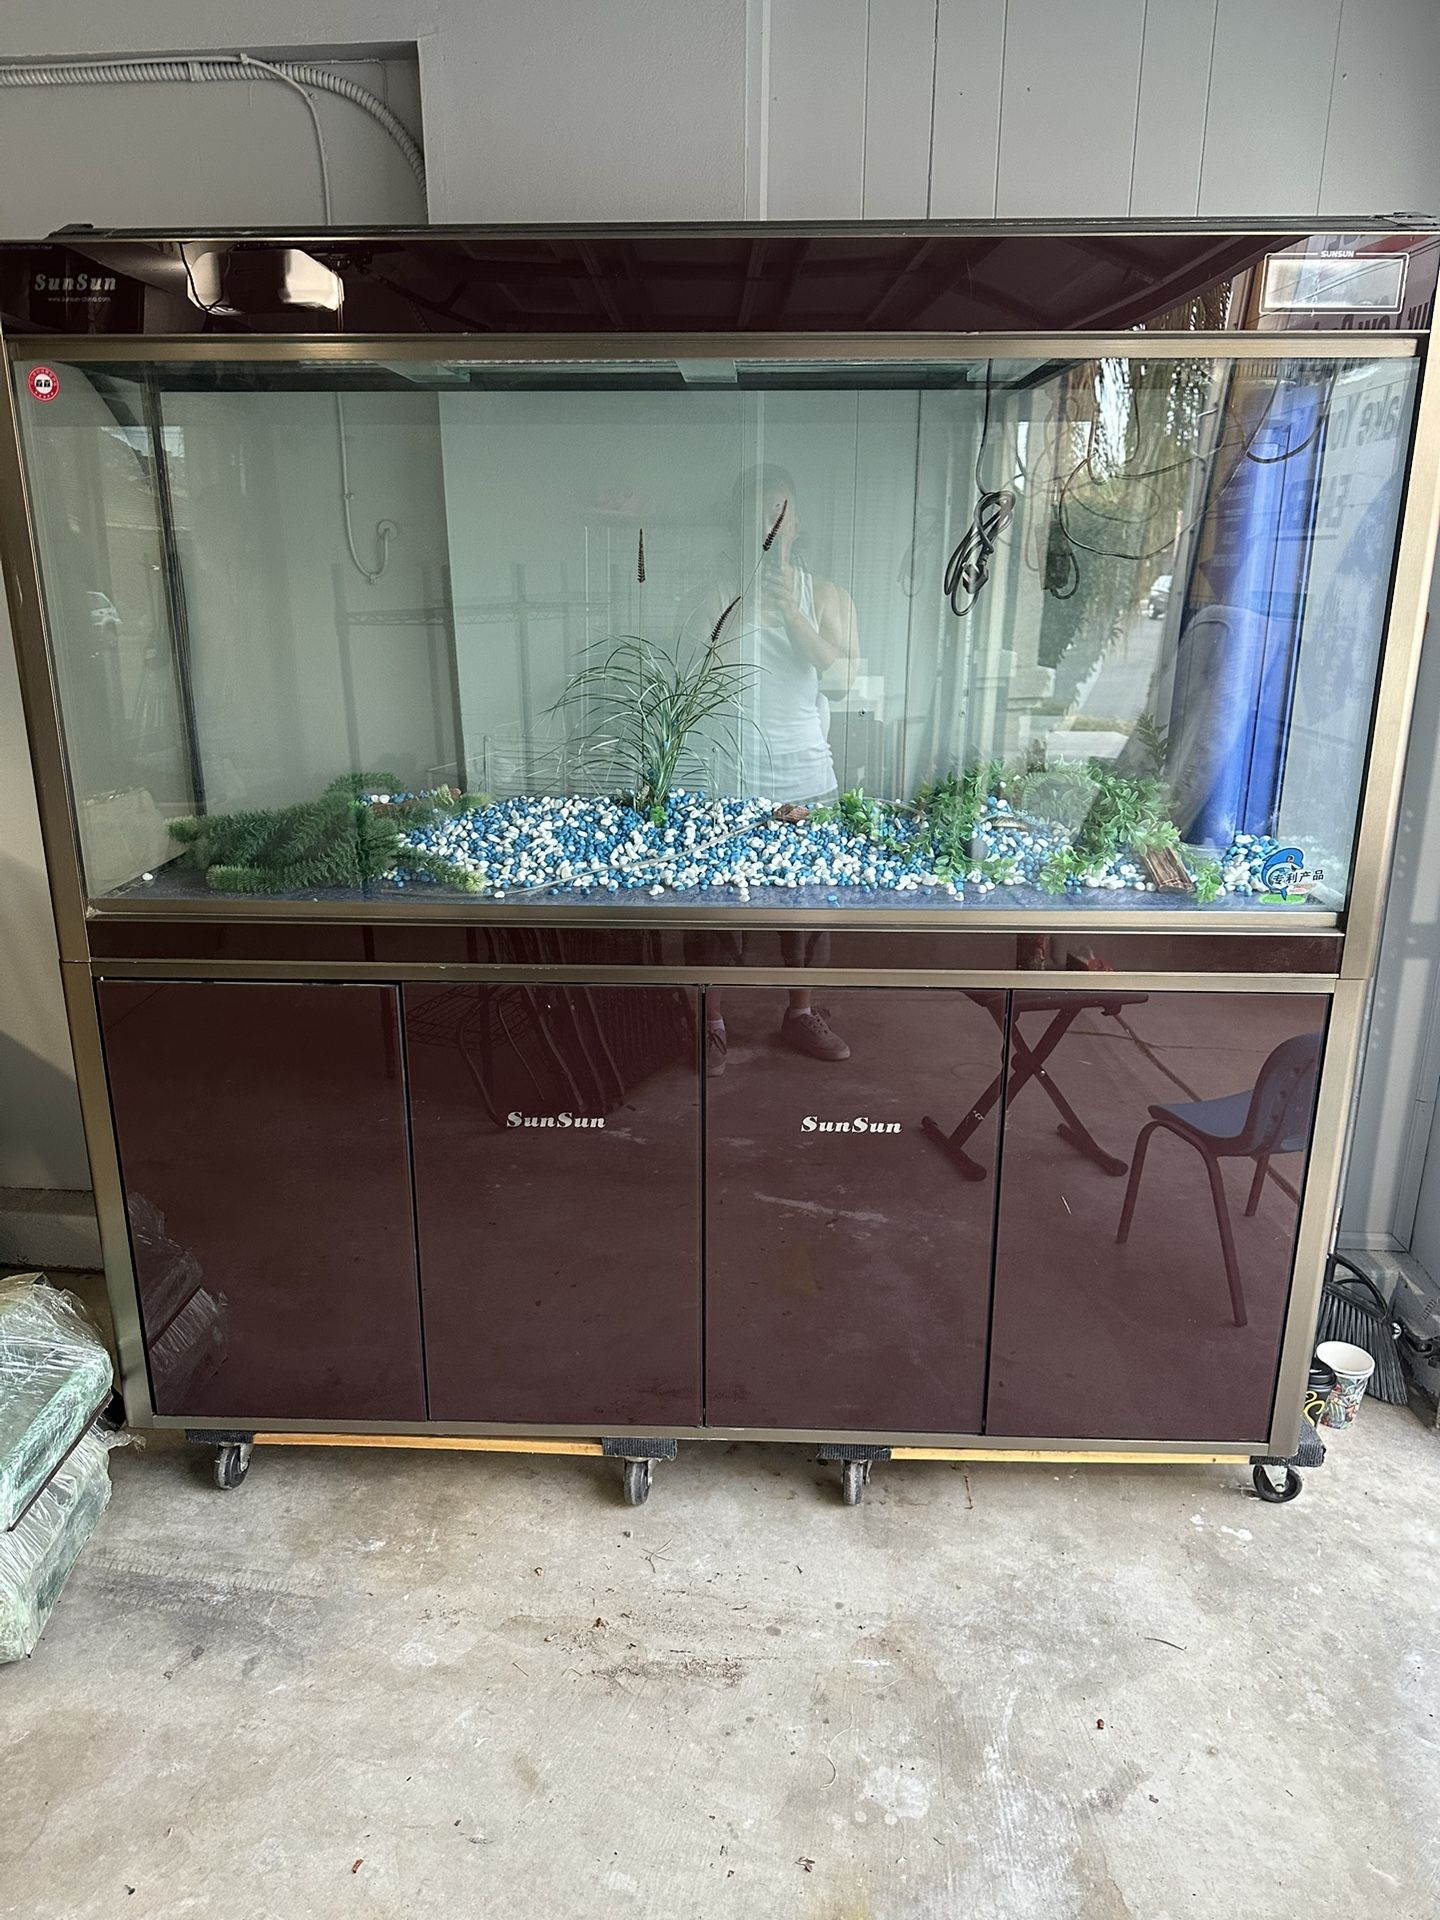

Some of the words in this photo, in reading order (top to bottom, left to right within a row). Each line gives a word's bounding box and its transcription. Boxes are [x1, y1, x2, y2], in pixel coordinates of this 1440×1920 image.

[1320, 250, 1355, 258] SUNSUN
[34, 273, 116, 291] SunSun
[1273, 869, 1324, 885] 专利产品
[506, 1111, 606, 1128] SunSun
[801, 1116, 902, 1133] SunSun
